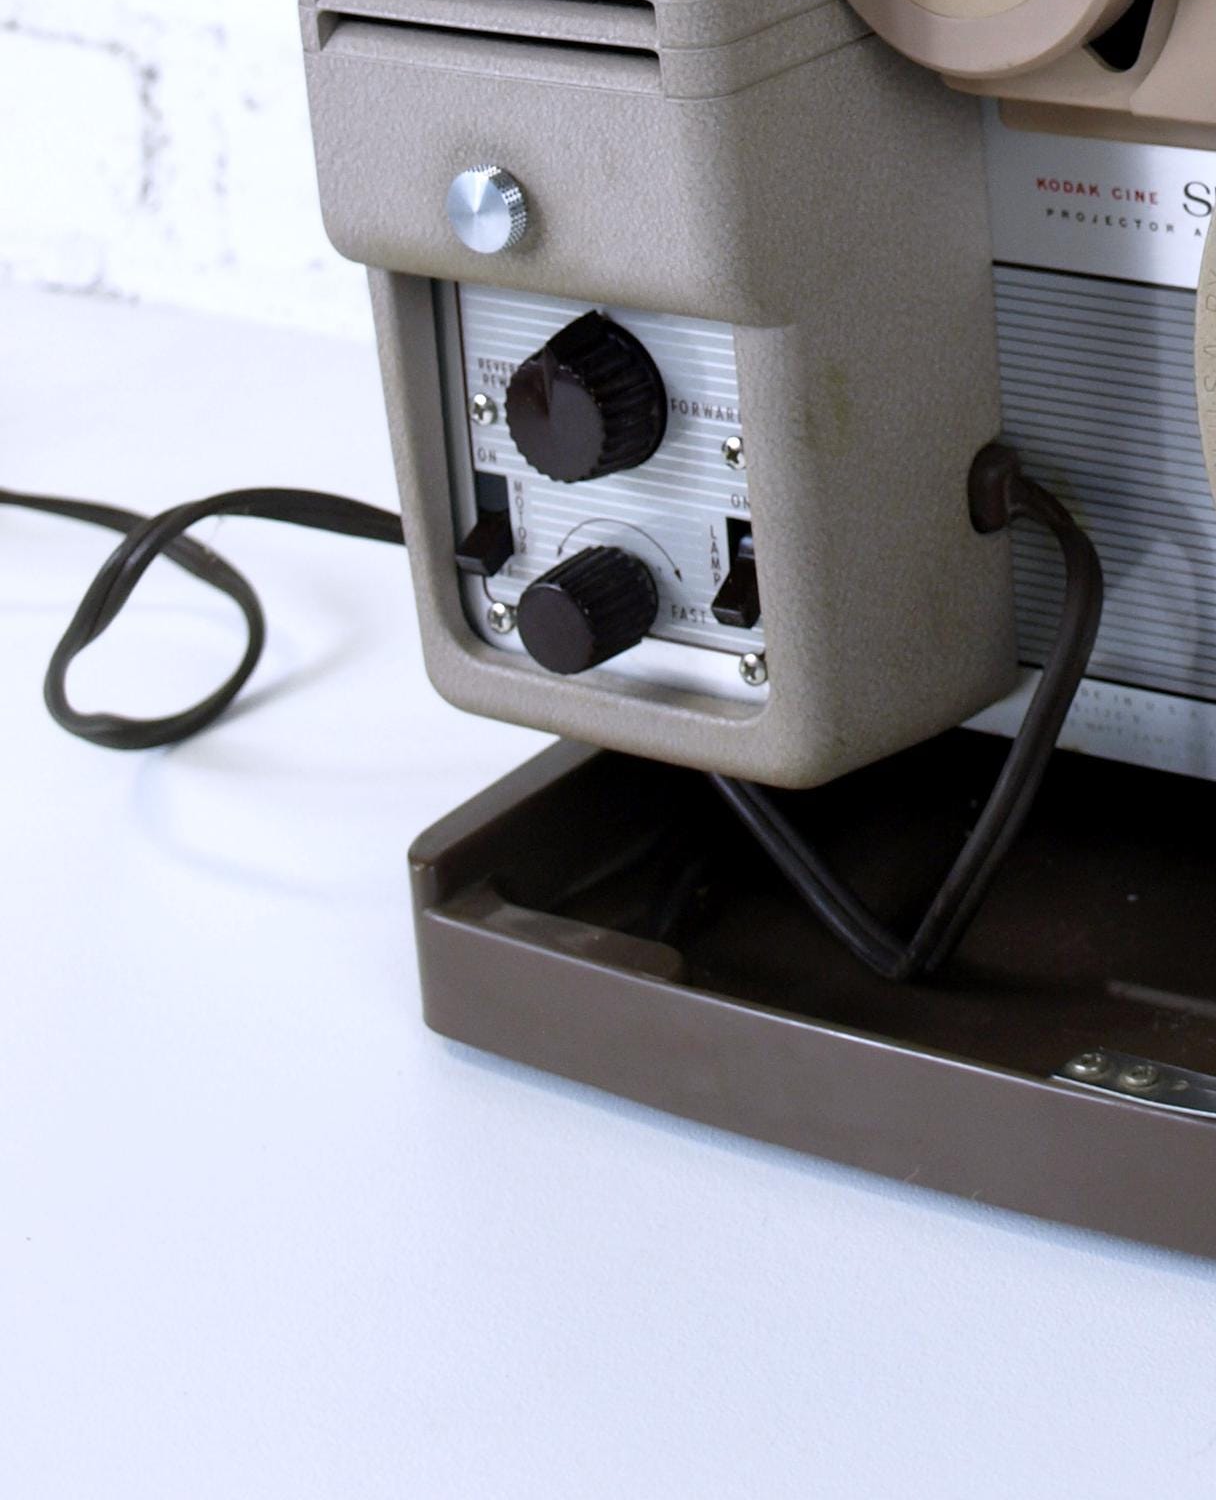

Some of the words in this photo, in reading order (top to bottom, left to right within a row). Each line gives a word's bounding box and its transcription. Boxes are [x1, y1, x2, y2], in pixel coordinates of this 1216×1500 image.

[1035, 177, 1100, 198] KODAK
[1112, 187, 1159, 206] CINE
[1046, 207, 1175, 234] PROJECTOR
[670, 398, 741, 423] FORWAR
[477, 446, 497, 463] ON
[513, 480, 527, 556] MOTOR
[710, 523, 721, 587] LAMP
[670, 603, 706, 625] FAST
